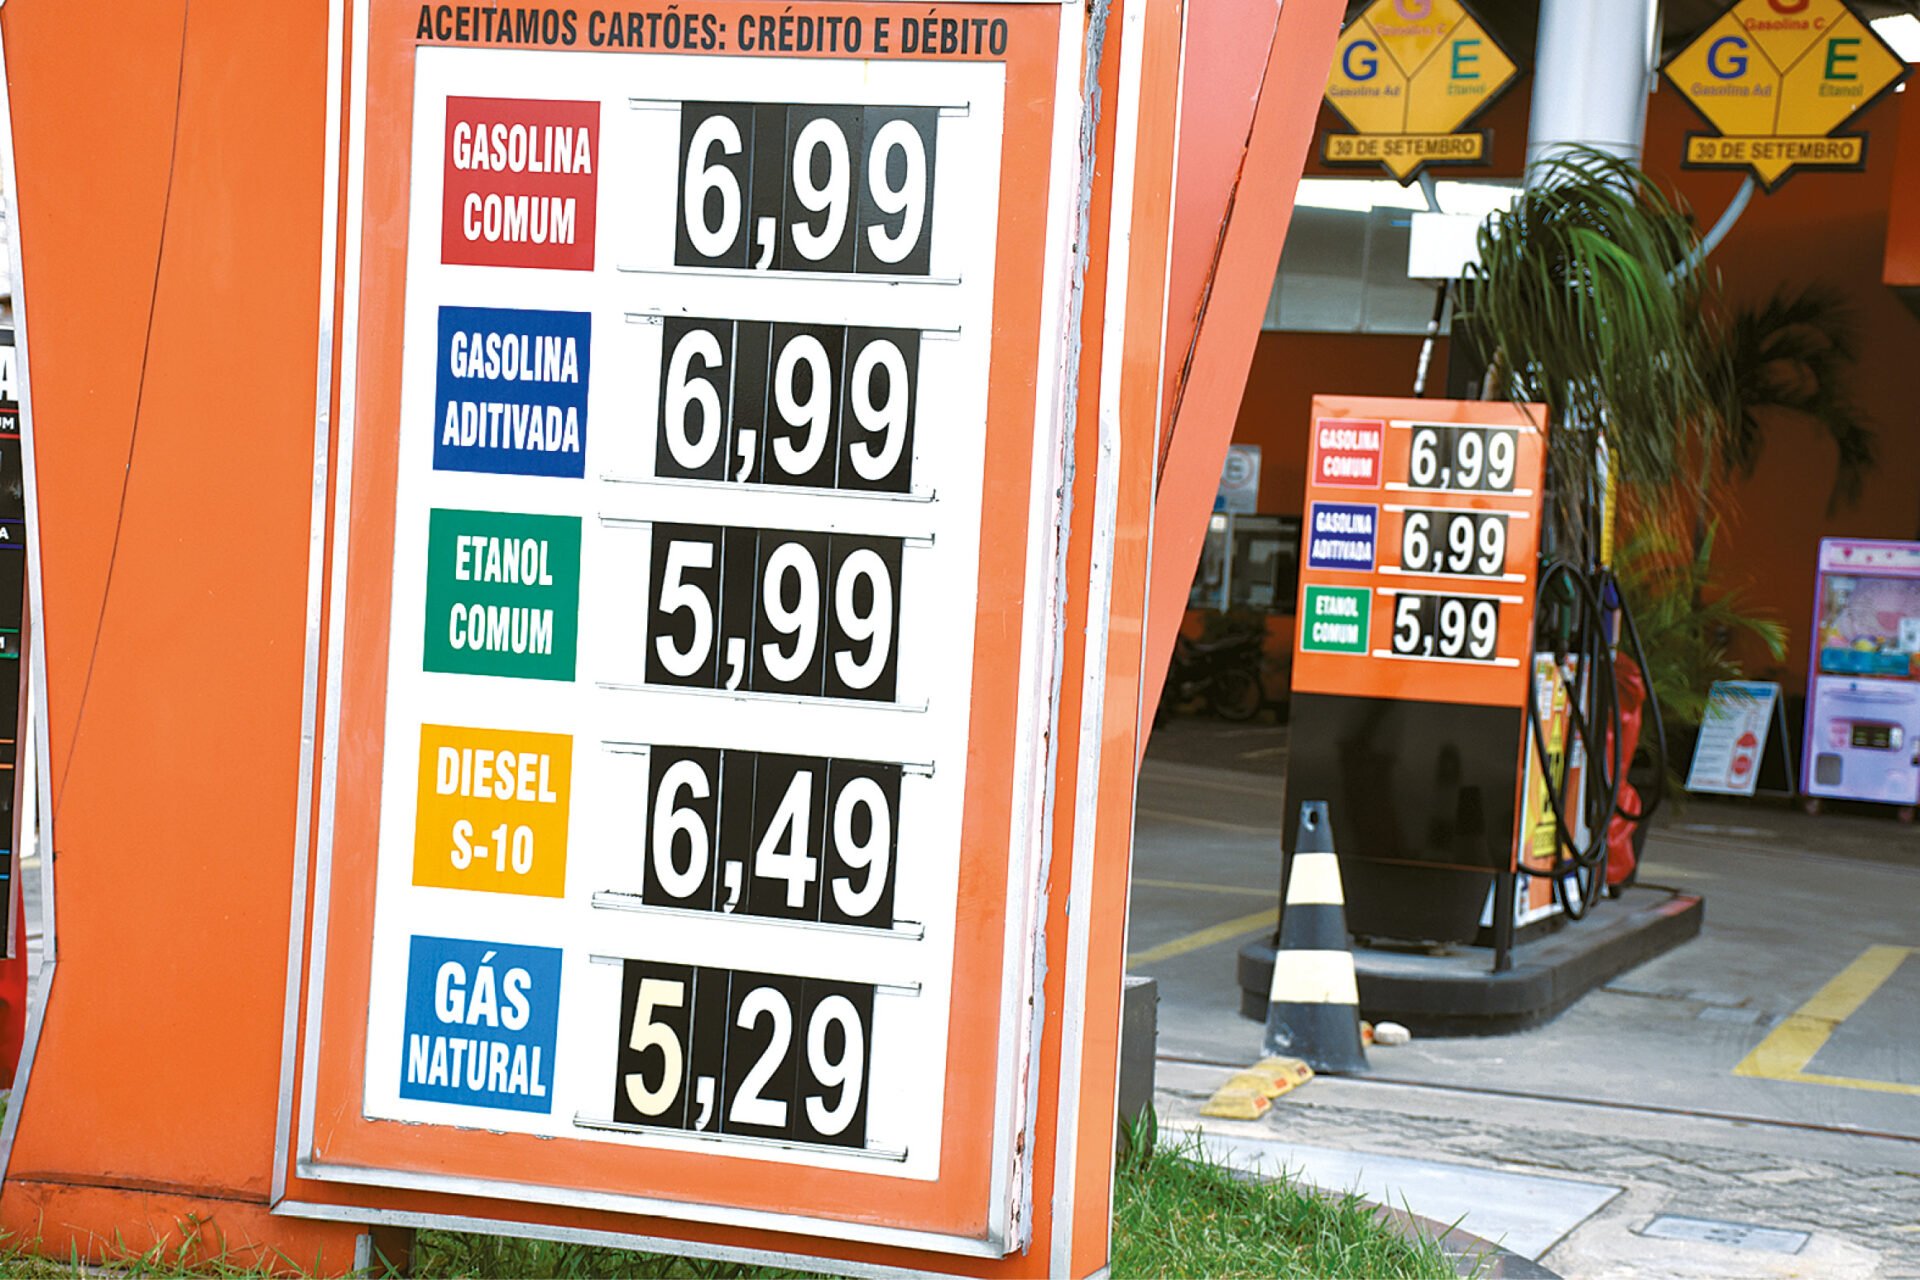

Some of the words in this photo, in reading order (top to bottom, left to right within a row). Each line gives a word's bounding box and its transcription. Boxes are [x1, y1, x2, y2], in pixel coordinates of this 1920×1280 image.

[416, 5, 578, 45] ACEITAMOS
[588, 6, 726, 52] CARTÕES:
[738, 9, 862, 53] CRÉDITO
[874, 18, 889, 53] E
[901, 12, 1008, 56] DÉBITO
[1342, 40, 1378, 81] G
[1451, 39, 1482, 80] E
[1707, 36, 1749, 80] G
[1824, 38, 1861, 80] E
[1819, 83, 1863, 97] Etanol
[452, 121, 592, 174] GASOLINA
[1335, 140, 1352, 156] 30
[1356, 140, 1377, 155] DE
[1383, 138, 1475, 156] SETEMBRO
[1696, 142, 1716, 159] 30
[1721, 142, 1745, 159] DE
[1752, 142, 1853, 160] SETEMBRO
[463, 193, 575, 244] COMUM
[683, 115, 928, 270] 6,99
[450, 331, 579, 383] GASOLINA
[442, 401, 580, 453] ADITIVADA
[664, 329, 909, 482] 6,99
[1319, 428, 1379, 451] GASOLINA
[1411, 429, 1515, 490] 6,99
[1323, 456, 1372, 478] COMUM
[1316, 512, 1372, 535] GASOLINA
[1403, 512, 1505, 575] 6,99
[455, 535, 552, 586] ETANOL
[448, 603, 553, 655] COMUM
[655, 540, 893, 690] 5,99
[1315, 595, 1358, 617] ETANOL
[1393, 597, 1497, 658] 5,99
[1312, 622, 1358, 644] COMUM
[436, 746, 557, 803] DIESEL
[450, 819, 534, 874] S-10
[652, 759, 891, 917] 6,49
[434, 951, 532, 1031] GÁS
[408, 1034, 546, 1097] NATURAL
[624, 977, 864, 1137] 5,29
